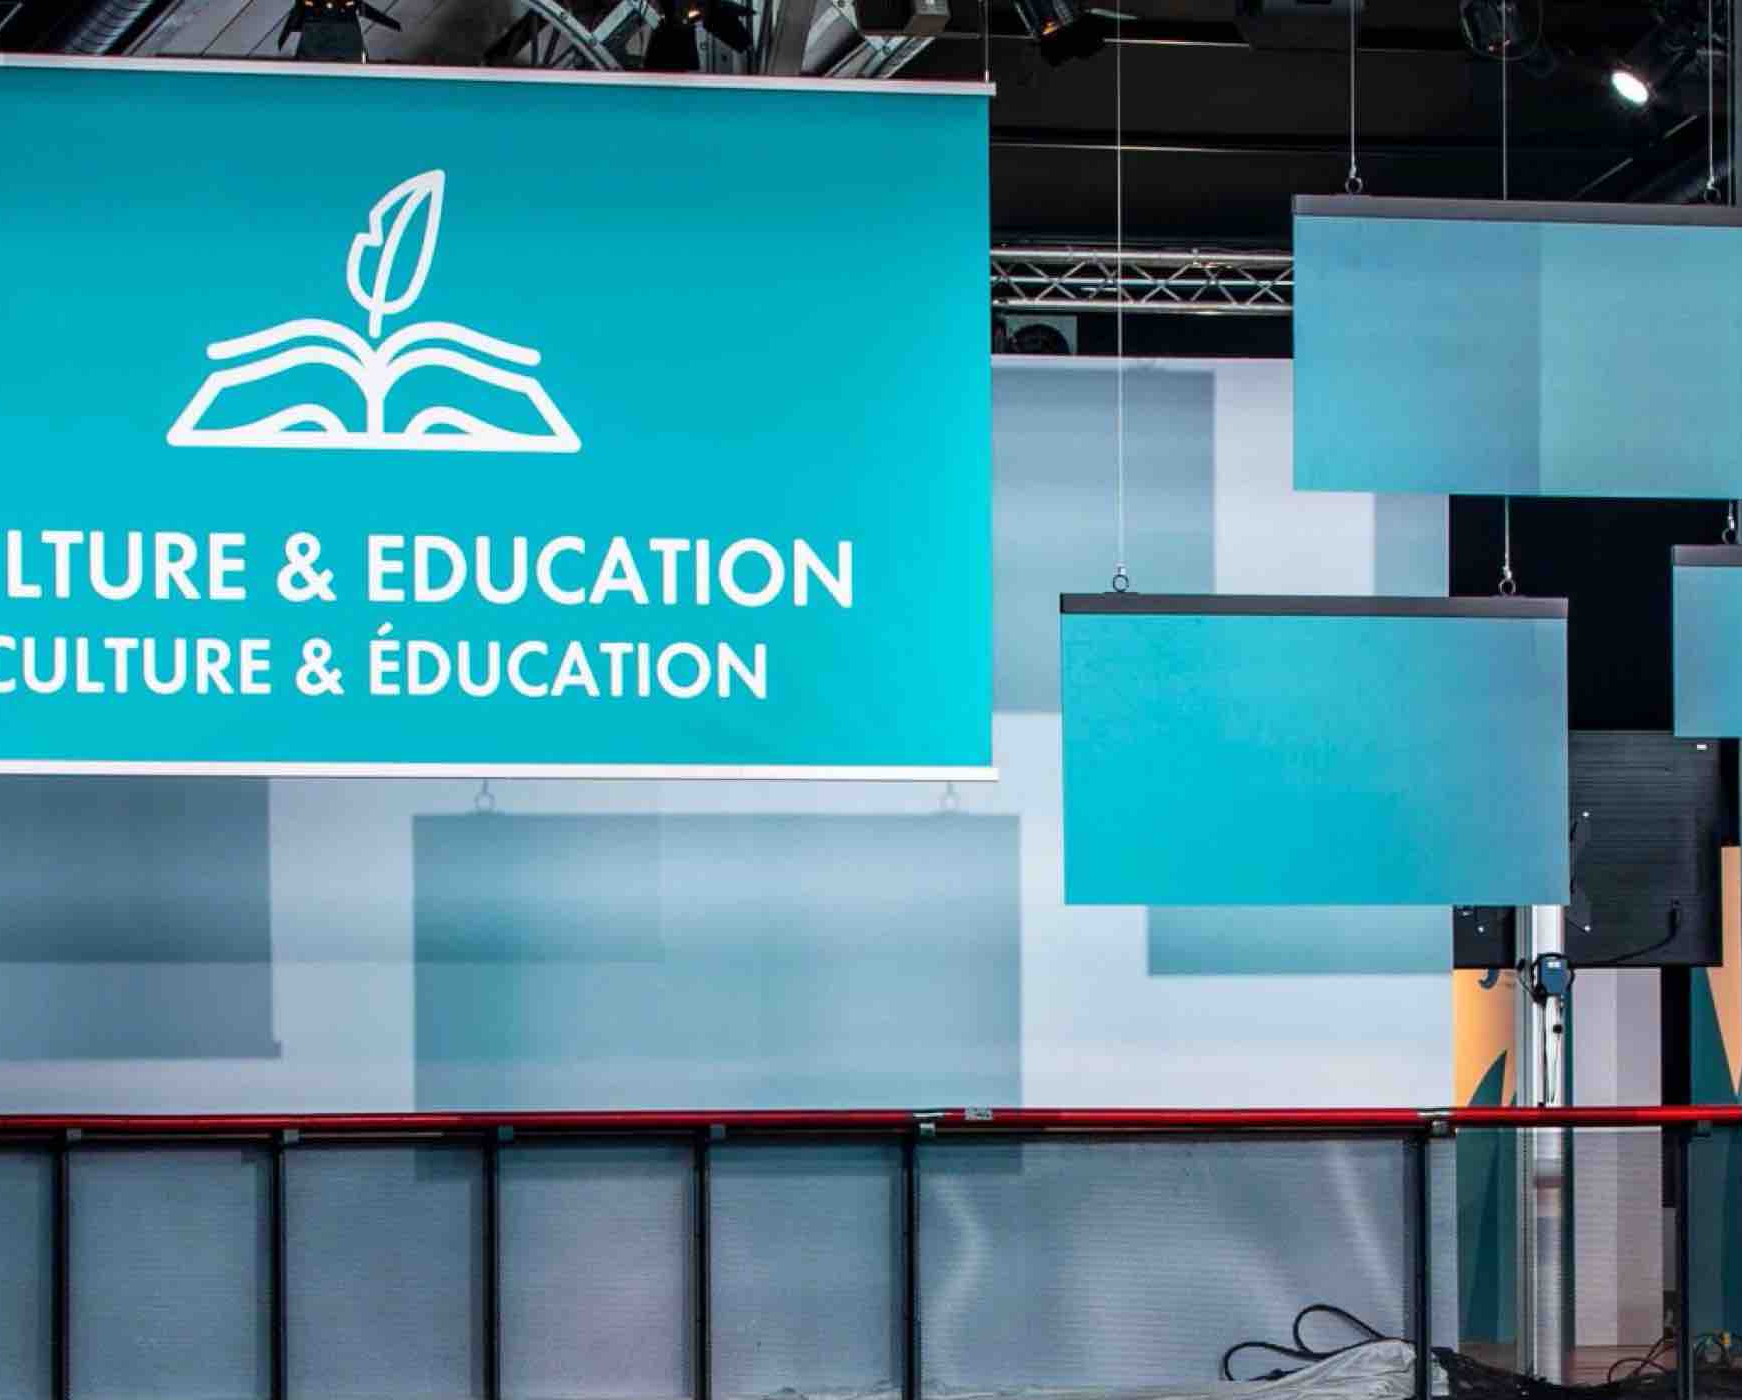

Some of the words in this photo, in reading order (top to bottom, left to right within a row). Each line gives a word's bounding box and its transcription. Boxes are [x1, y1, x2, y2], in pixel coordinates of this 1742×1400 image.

[276, 530, 338, 604] &
[367, 534, 854, 609] EDUCATION
[294, 637, 346, 697] &
[369, 622, 766, 699] ÉDUCATION
